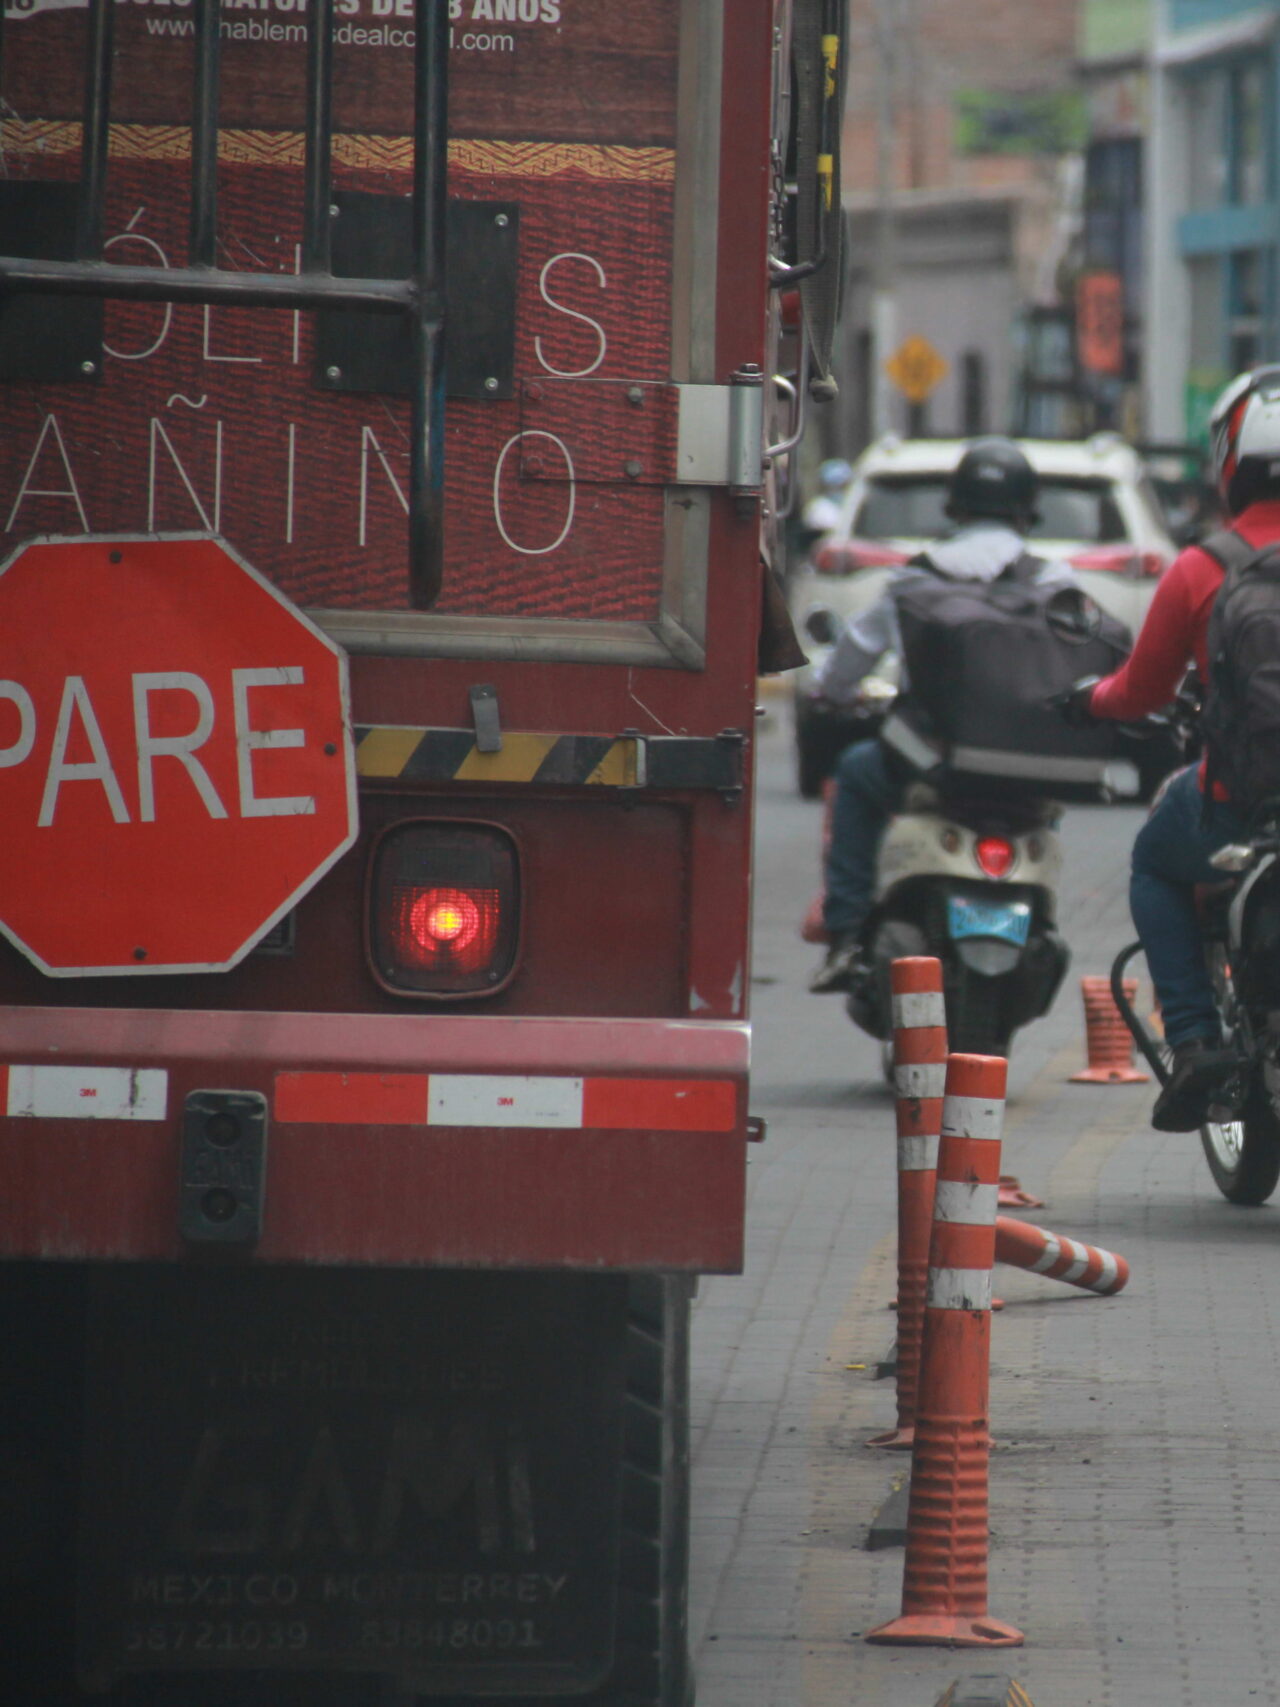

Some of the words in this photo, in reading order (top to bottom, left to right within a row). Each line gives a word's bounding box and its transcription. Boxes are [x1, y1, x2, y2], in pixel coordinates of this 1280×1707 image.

[79, 1088, 97, 1097] 3M
[497, 1097, 514, 1106] 3M
[131, 1573, 299, 1606] MEXICO
